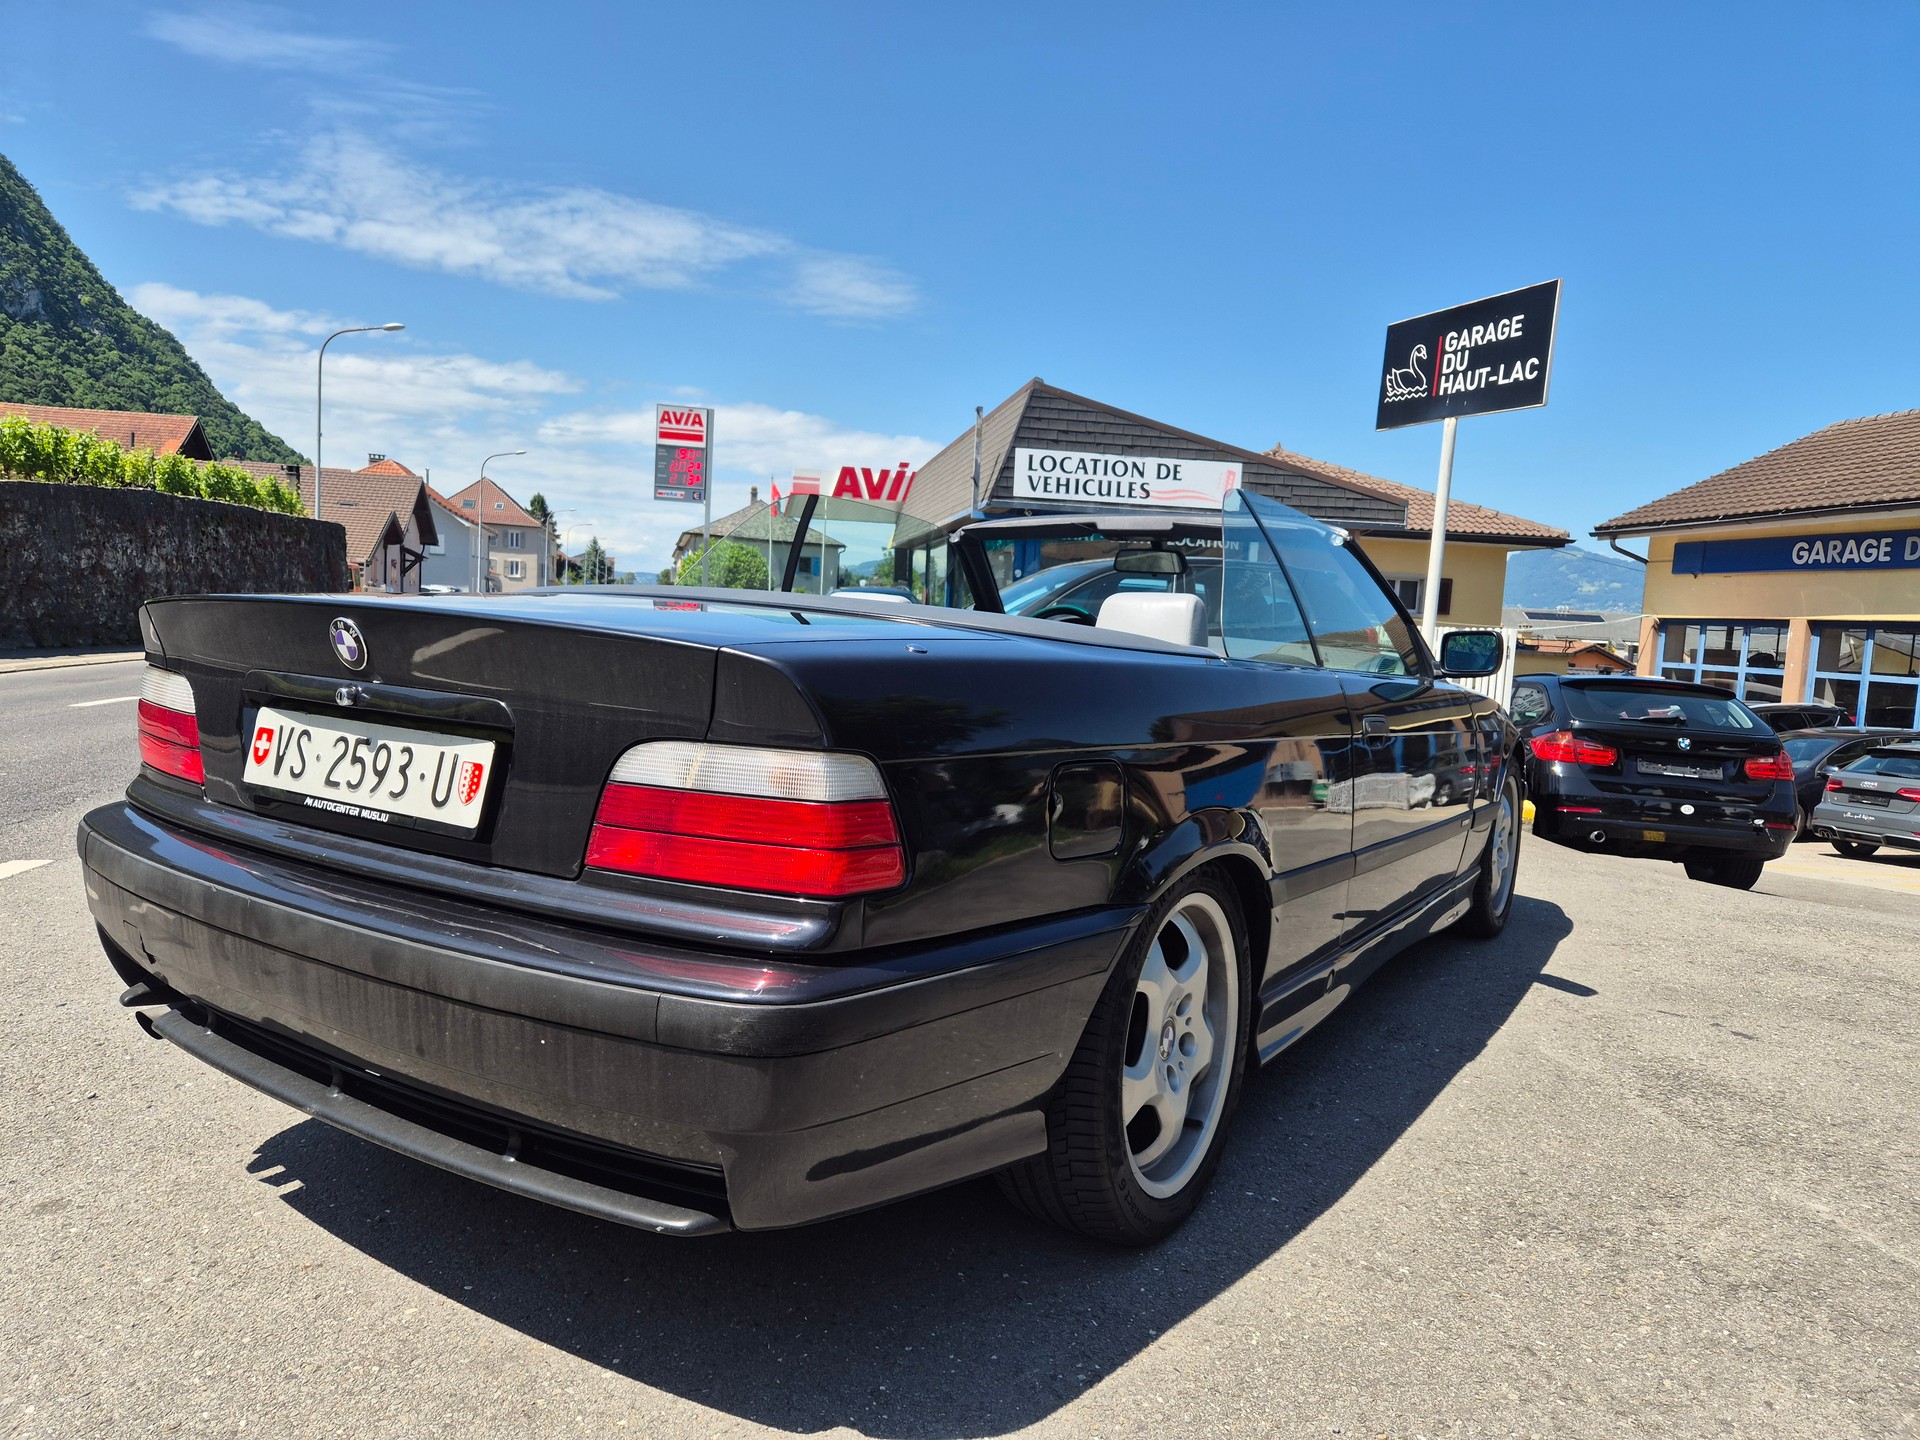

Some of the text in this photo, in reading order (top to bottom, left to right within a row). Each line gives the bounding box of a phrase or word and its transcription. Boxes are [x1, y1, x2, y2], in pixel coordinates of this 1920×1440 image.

[1445, 314, 1524, 352] GARAGE
[1442, 350, 1469, 374] DU
[1439, 357, 1539, 396] HAUT-LAC
[1027, 454, 1183, 481] LOCATION DE
[1027, 475, 1151, 499] VEHICULES
[1792, 537, 1893, 565] GARAGE
[313, 799, 360, 817] AUTOCENTER
[361, 808, 389, 823] MUSLIU
